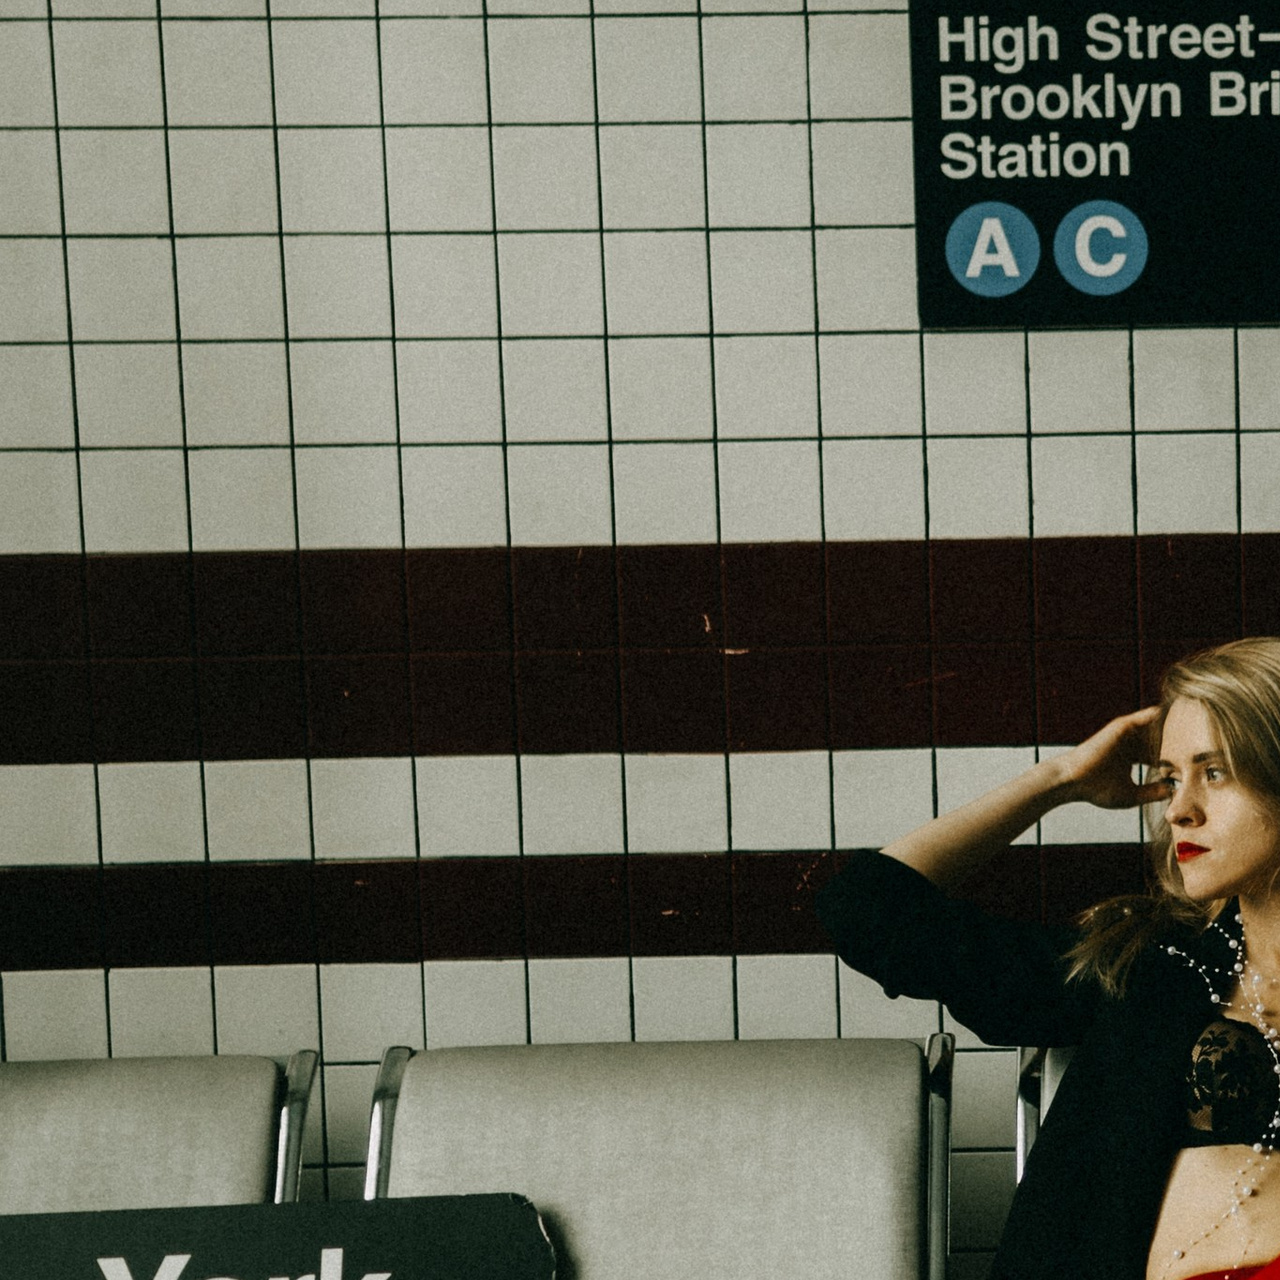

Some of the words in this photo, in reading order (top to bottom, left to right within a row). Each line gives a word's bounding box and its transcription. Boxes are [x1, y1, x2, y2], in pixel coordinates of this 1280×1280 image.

[937, 14, 1060, 75] High
[939, 71, 1183, 131] Brooklyn
[939, 131, 1131, 180] Station
[964, 217, 1021, 279] A
[1074, 214, 1128, 278] C
